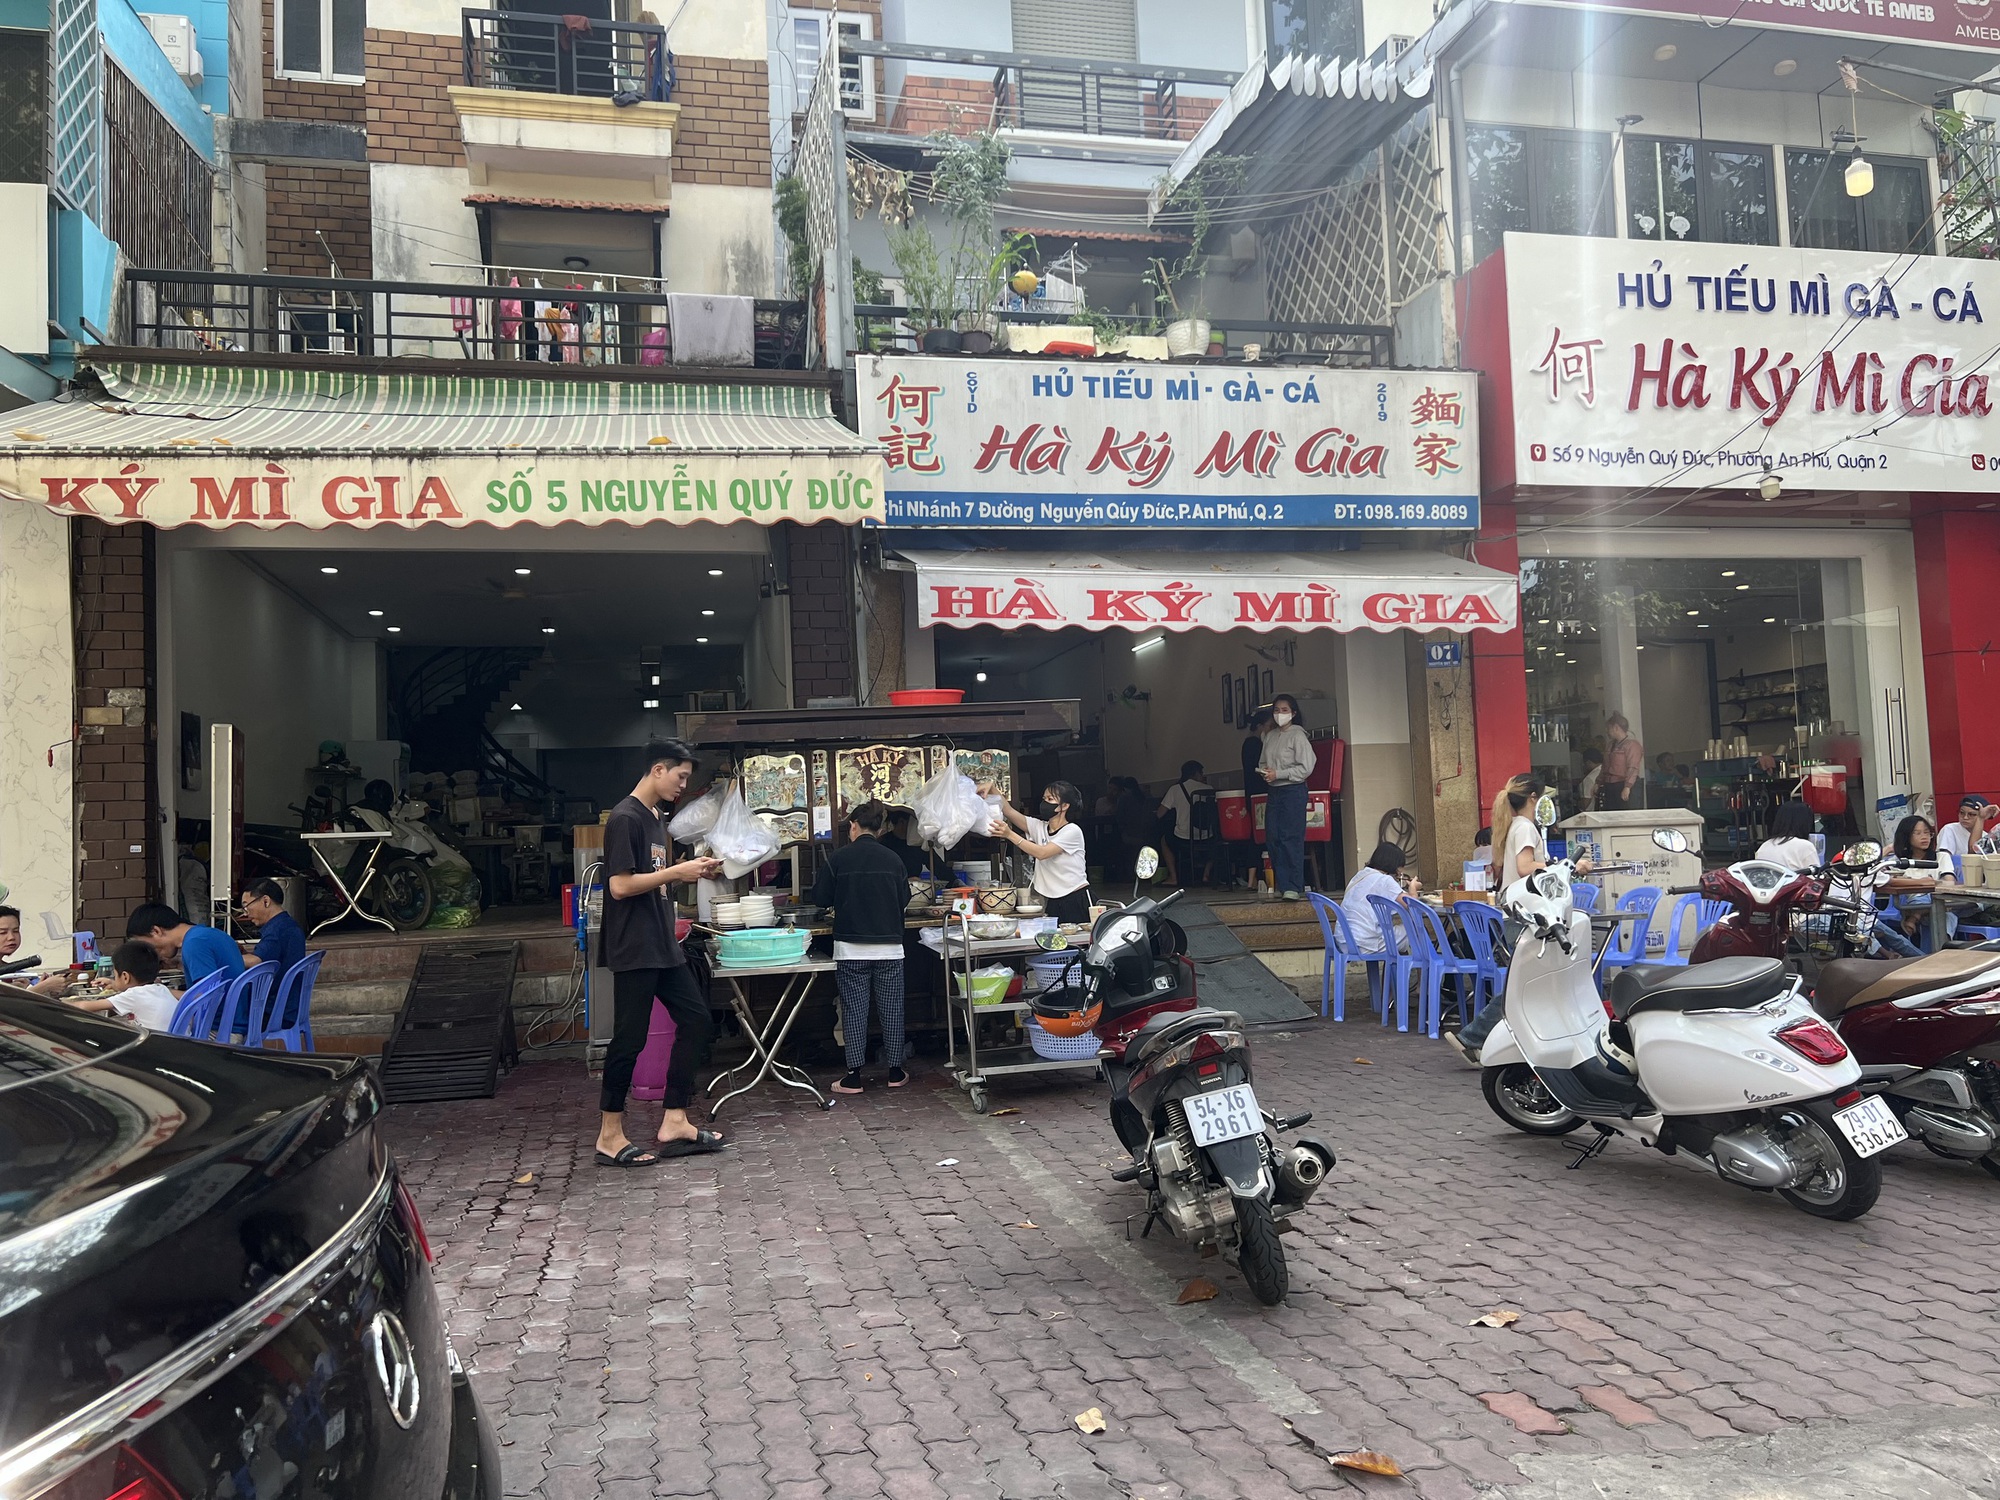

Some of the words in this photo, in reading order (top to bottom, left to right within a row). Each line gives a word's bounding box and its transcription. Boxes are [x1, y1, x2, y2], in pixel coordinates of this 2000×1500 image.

[1888, 1, 1935, 22] AMEB
[1617, 259, 1673, 309] HỦ
[1687, 263, 1777, 314] TIẾU
[1789, 272, 1831, 316] MÌ
[1844, 276, 1900, 320] GÀ
[1932, 281, 1984, 324] CÁ
[1532, 326, 1605, 407] 何
[1626, 337, 1711, 412] Hà
[1728, 346, 1801, 427] Ký
[1812, 350, 1888, 414] Mì
[1899, 352, 1993, 418] Gia
[966, 371, 978, 414] COVID
[1032, 367, 1074, 398] HỦ
[1082, 369, 1153, 400] TIẾU
[1166, 371, 1199, 400] MÌ
[1283, 375, 1320, 403] CÁ
[1377, 383, 1388, 422] 2019
[973, 423, 1071, 474] Hà
[1085, 426, 1174, 488] Ký
[1194, 428, 1285, 479] Mì
[1295, 427, 1387, 479] Gia
[1553, 444, 1572, 463] Số
[1575, 448, 1584, 463] 9
[1589, 445, 1645, 468] Nguyễn
[1649, 450, 1678, 469] Quý
[1682, 449, 1714, 468] Đức,
[1718, 450, 1773, 470] Phường
[1778, 453, 1798, 468] An
[1802, 451, 1831, 470] Phú,
[1837, 454, 1876, 472] Quận
[1879, 455, 1888, 469] 2
[40, 463, 165, 519] KÝ
[190, 462, 295, 520] MÌ
[322, 475, 467, 520] GIA
[486, 467, 534, 513] SỐ
[547, 480, 568, 513] 5
[581, 464, 718, 512] NGUYỄN
[728, 470, 793, 516] QUÝ
[807, 469, 874, 511] ĐỨC
[907, 500, 961, 518] Nhánh
[965, 503, 974, 517] 7
[979, 500, 1034, 523] Đường
[1041, 498, 1104, 523] Nguyễn
[1334, 504, 1362, 520] ĐT:
[1364, 504, 1468, 520] 098.169.8089
[930, 577, 1066, 621] HÀ
[1086, 581, 1212, 622] KÝ
[1233, 582, 1341, 623] MÌ
[1362, 593, 1508, 624] GIA
[1431, 645, 1454, 660] 07
[1743, 1089, 1793, 1103] Vespa
[1201, 1111, 1252, 1140] 2961
[1842, 1102, 1885, 1133] 79-D1
[1851, 1120, 1904, 1153] 536.42
